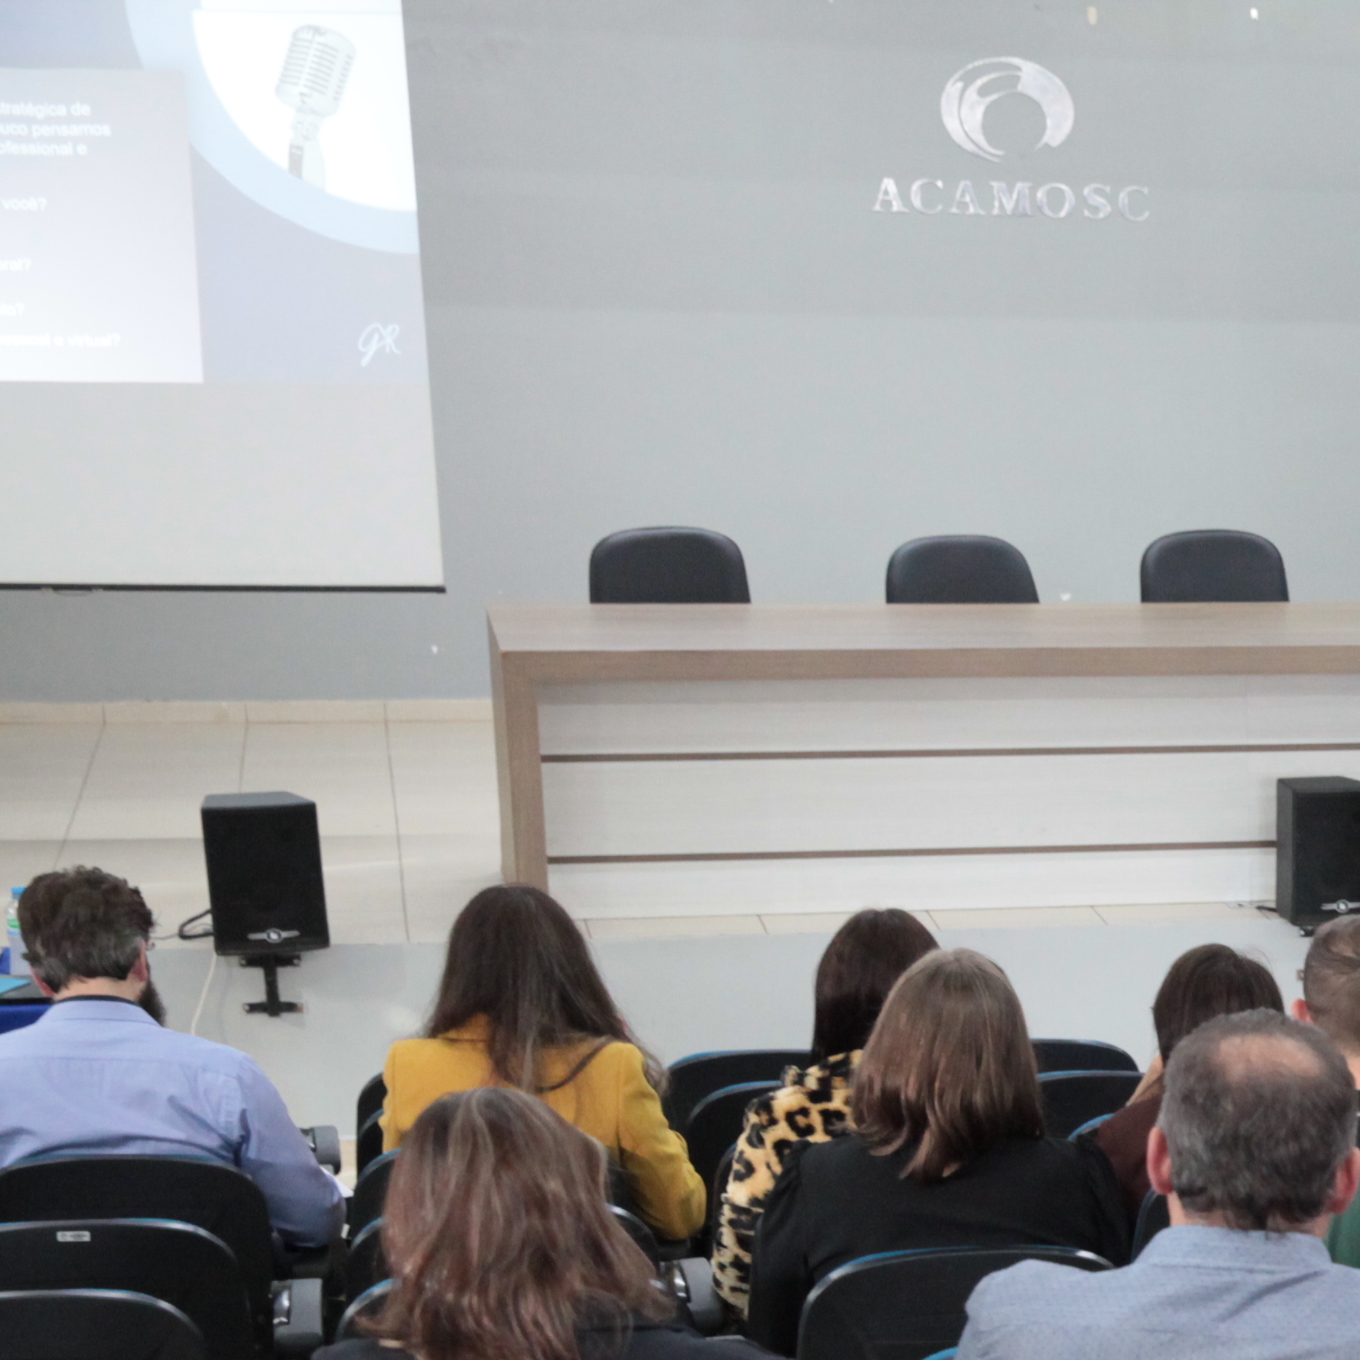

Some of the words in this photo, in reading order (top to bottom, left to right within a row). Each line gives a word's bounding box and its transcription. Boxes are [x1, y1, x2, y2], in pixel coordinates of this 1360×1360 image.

[70, 102, 91, 117] de
[31, 124, 112, 139] pensamos
[871, 176, 1150, 221] ACAMOSC
